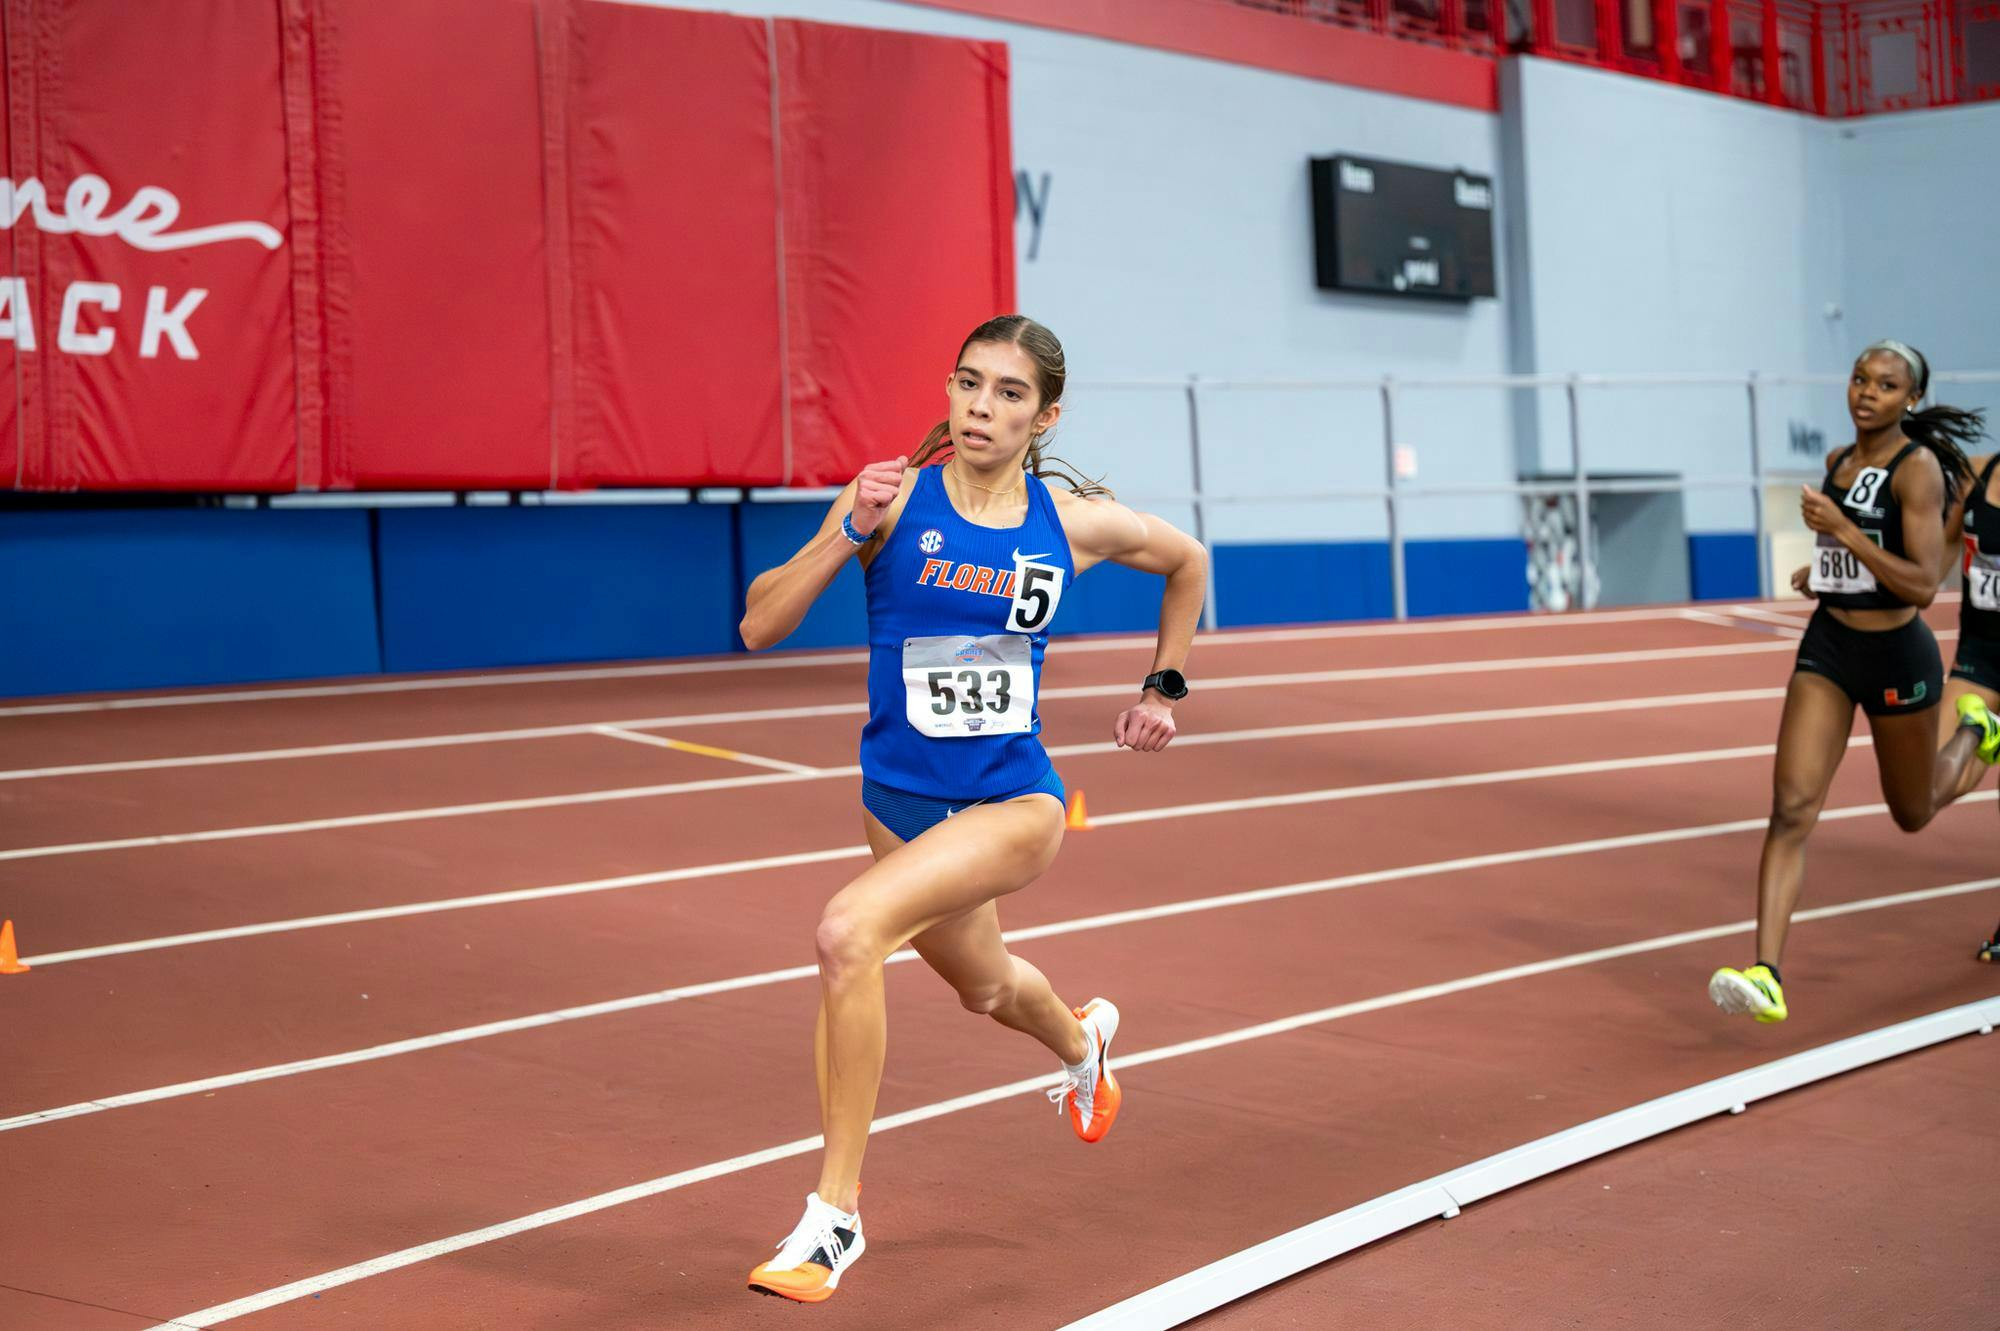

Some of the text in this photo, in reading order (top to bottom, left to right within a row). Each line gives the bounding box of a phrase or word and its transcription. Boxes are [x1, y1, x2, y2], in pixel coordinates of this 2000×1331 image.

[1852, 472, 1879, 504] 8
[919, 529, 943, 554] SEC
[1820, 550, 1859, 580] 680
[1016, 566, 1054, 629] 5
[928, 669, 1012, 716] 533
